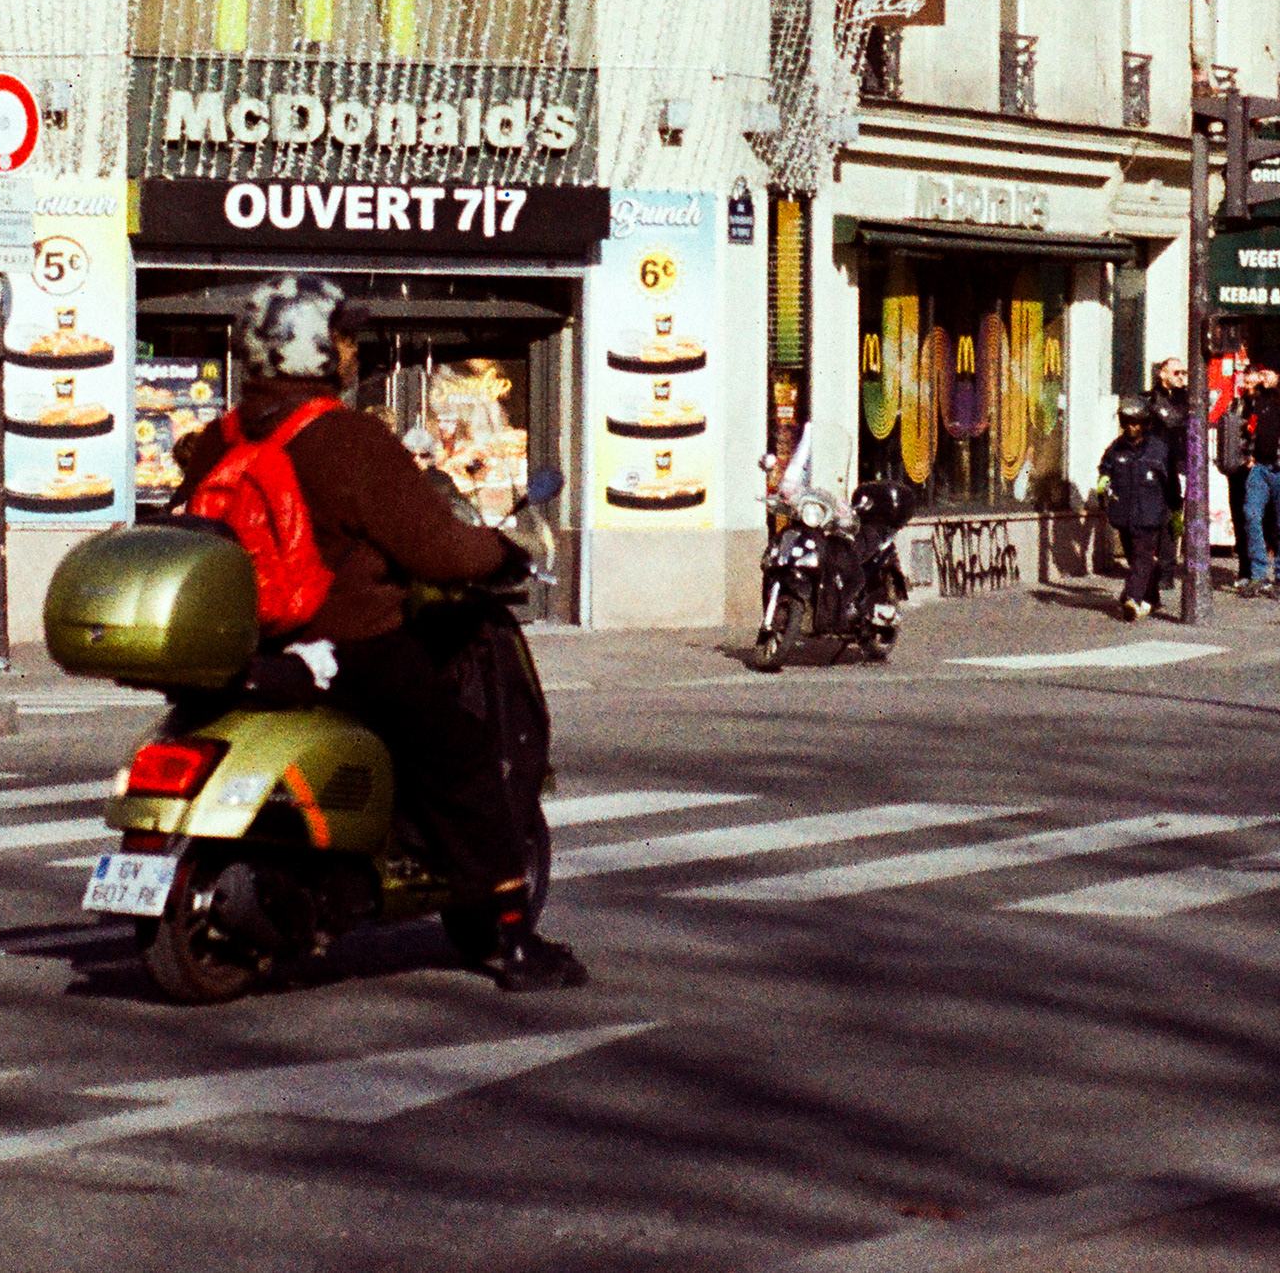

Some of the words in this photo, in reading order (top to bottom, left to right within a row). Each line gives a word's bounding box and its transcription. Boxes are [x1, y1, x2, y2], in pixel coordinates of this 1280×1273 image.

[163, 90, 578, 151] McDonald's
[35, 193, 118, 218] ouceur
[224, 183, 446, 230] OUVERT
[611, 197, 704, 239] Brunch
[44, 252, 81, 282] 5€
[640, 260, 674, 289] 6€
[1219, 285, 1268, 305] KEBAB
